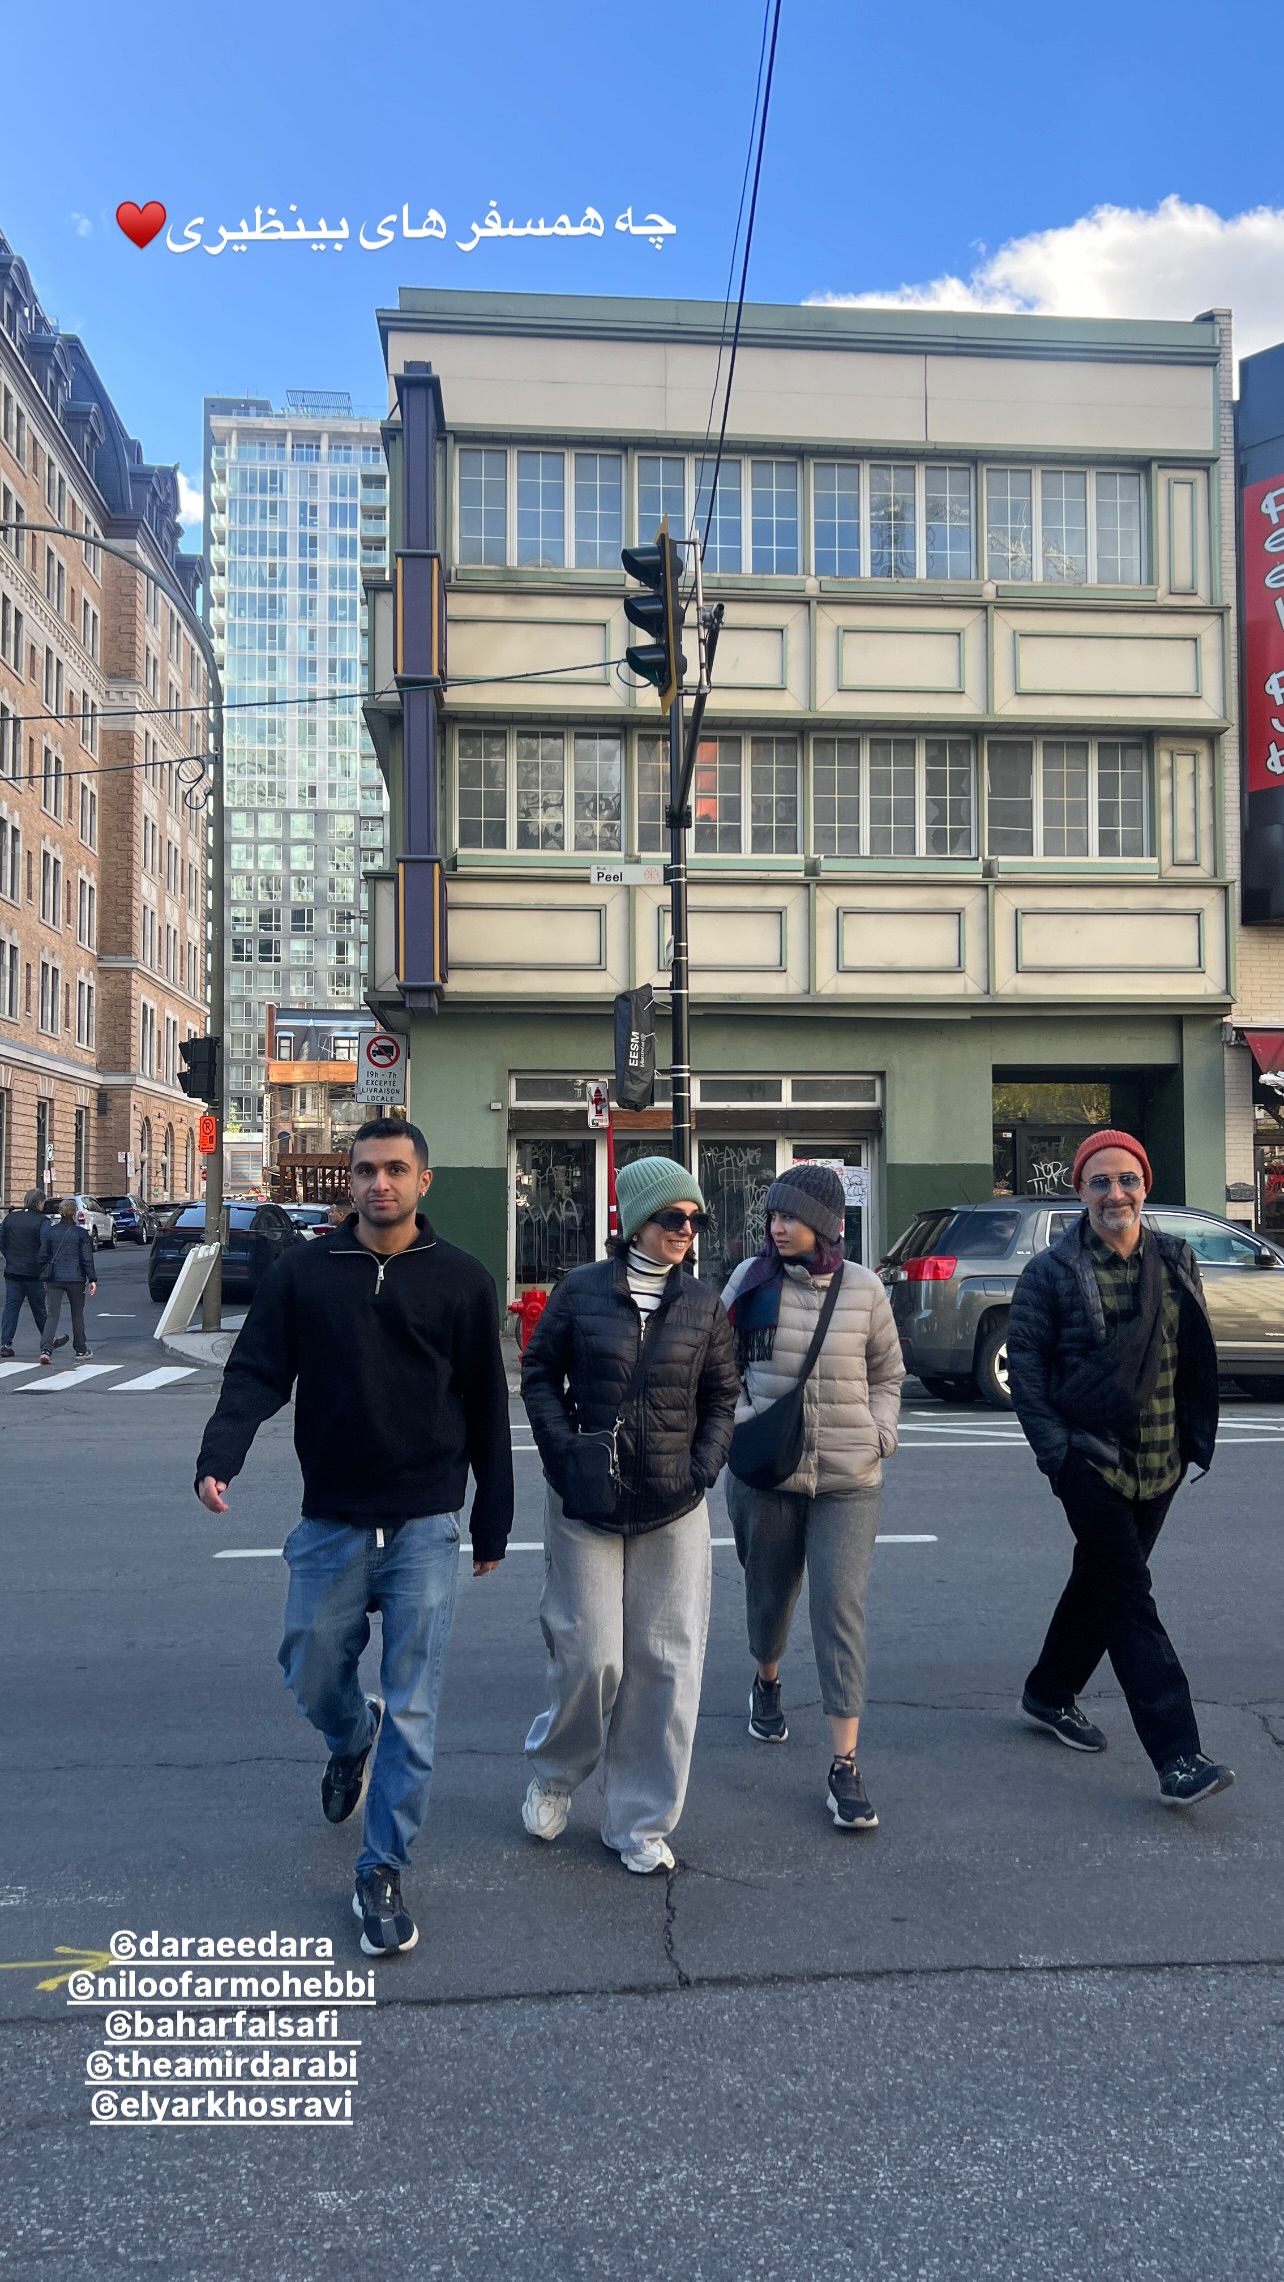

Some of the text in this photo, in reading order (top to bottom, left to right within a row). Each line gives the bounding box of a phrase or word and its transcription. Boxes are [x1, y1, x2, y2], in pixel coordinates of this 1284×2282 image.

[596, 871, 623, 882] Peel
[629, 1031, 640, 1067] EESM
[366, 1070, 379, 1078] 19h
[388, 1071, 397, 1079] 7h
[365, 1079, 397, 1087] EXCEPTÉ
[361, 1087, 400, 1095] LIVRAISON
[366, 1095, 395, 1103] LOCALE
